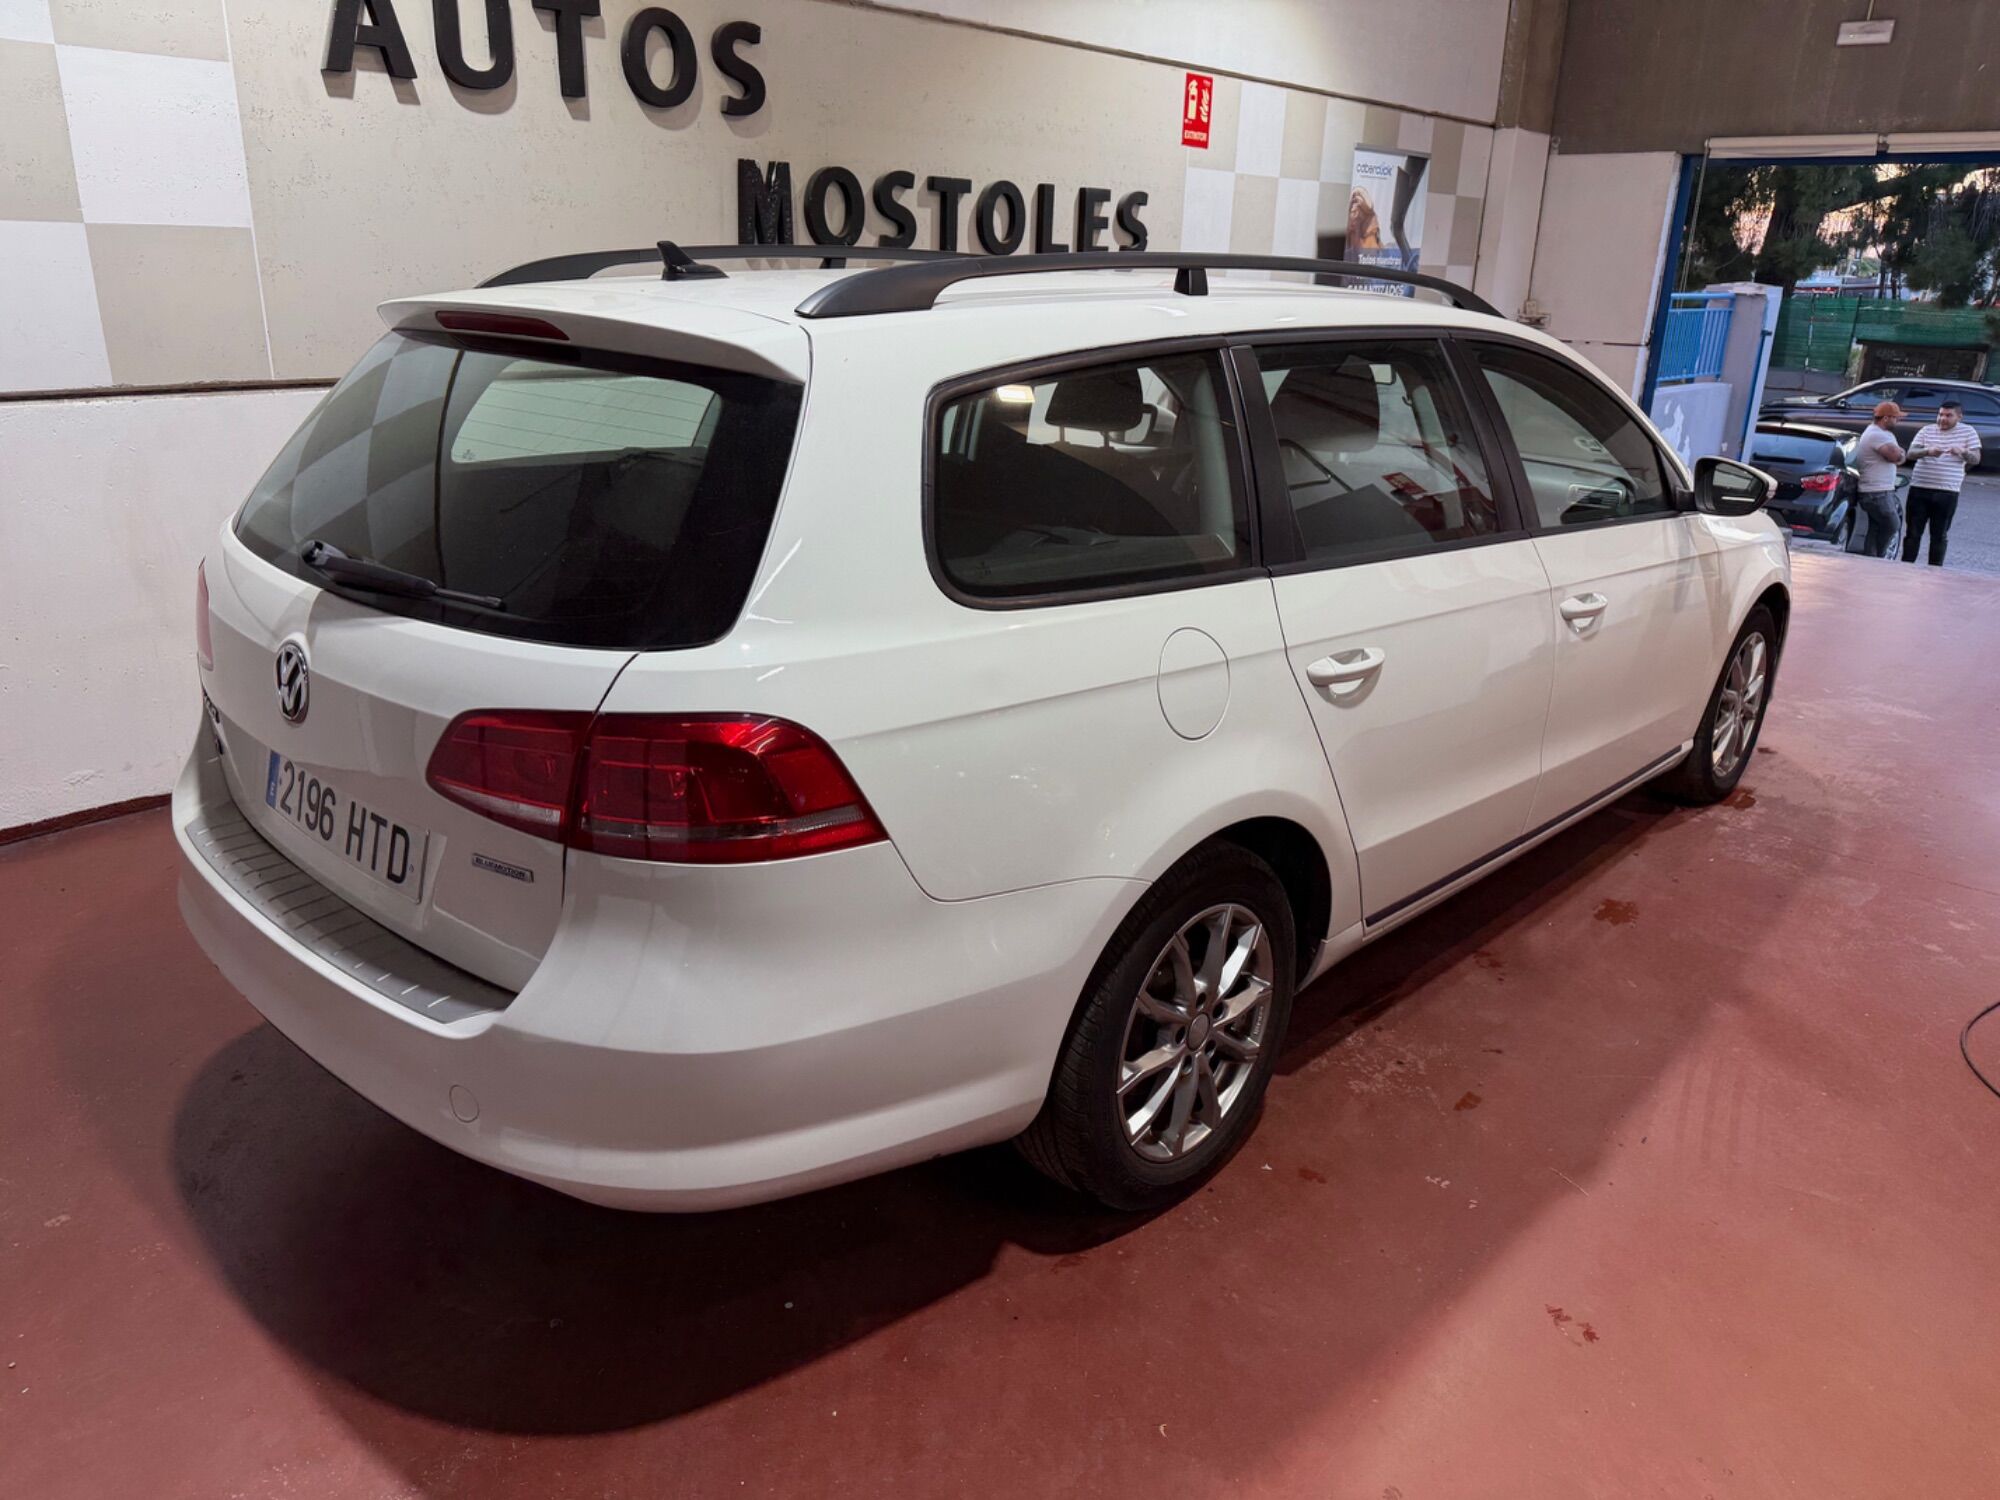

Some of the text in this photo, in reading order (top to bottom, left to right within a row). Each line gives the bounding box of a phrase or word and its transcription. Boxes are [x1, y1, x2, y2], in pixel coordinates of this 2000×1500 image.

[320, 0, 767, 117] AUTOS
[737, 157, 1149, 257] MOSTOLES
[280, 760, 411, 884] 2196 HTD
